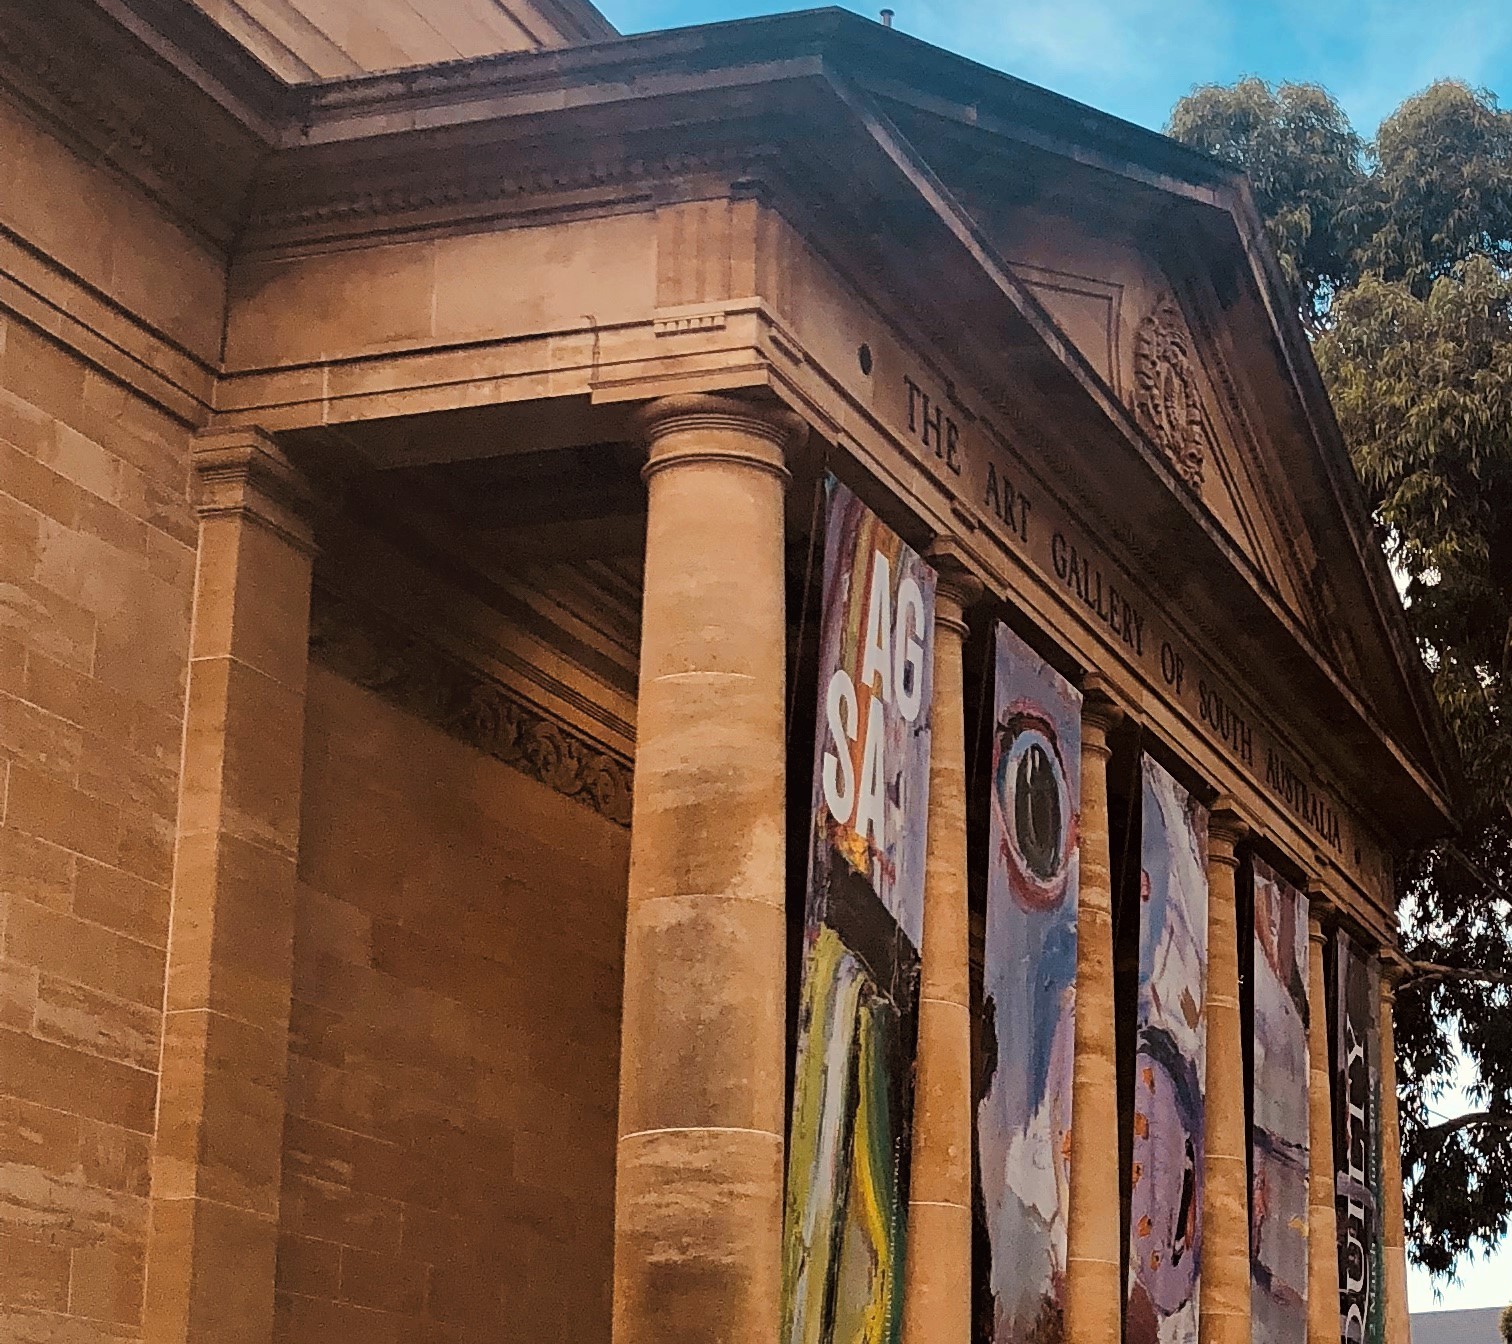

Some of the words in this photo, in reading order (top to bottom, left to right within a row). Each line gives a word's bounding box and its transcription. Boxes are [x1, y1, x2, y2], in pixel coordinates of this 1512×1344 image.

[861, 549, 924, 722] AG
[902, 374, 962, 477] THE
[983, 462, 1032, 545] ART
[1051, 532, 1146, 658] GALLERY
[1160, 641, 1185, 695] OF
[1200, 684, 1254, 761] SOUTH
[1265, 749, 1342, 855] AUSTRALIA
[822, 669, 885, 852] SA
